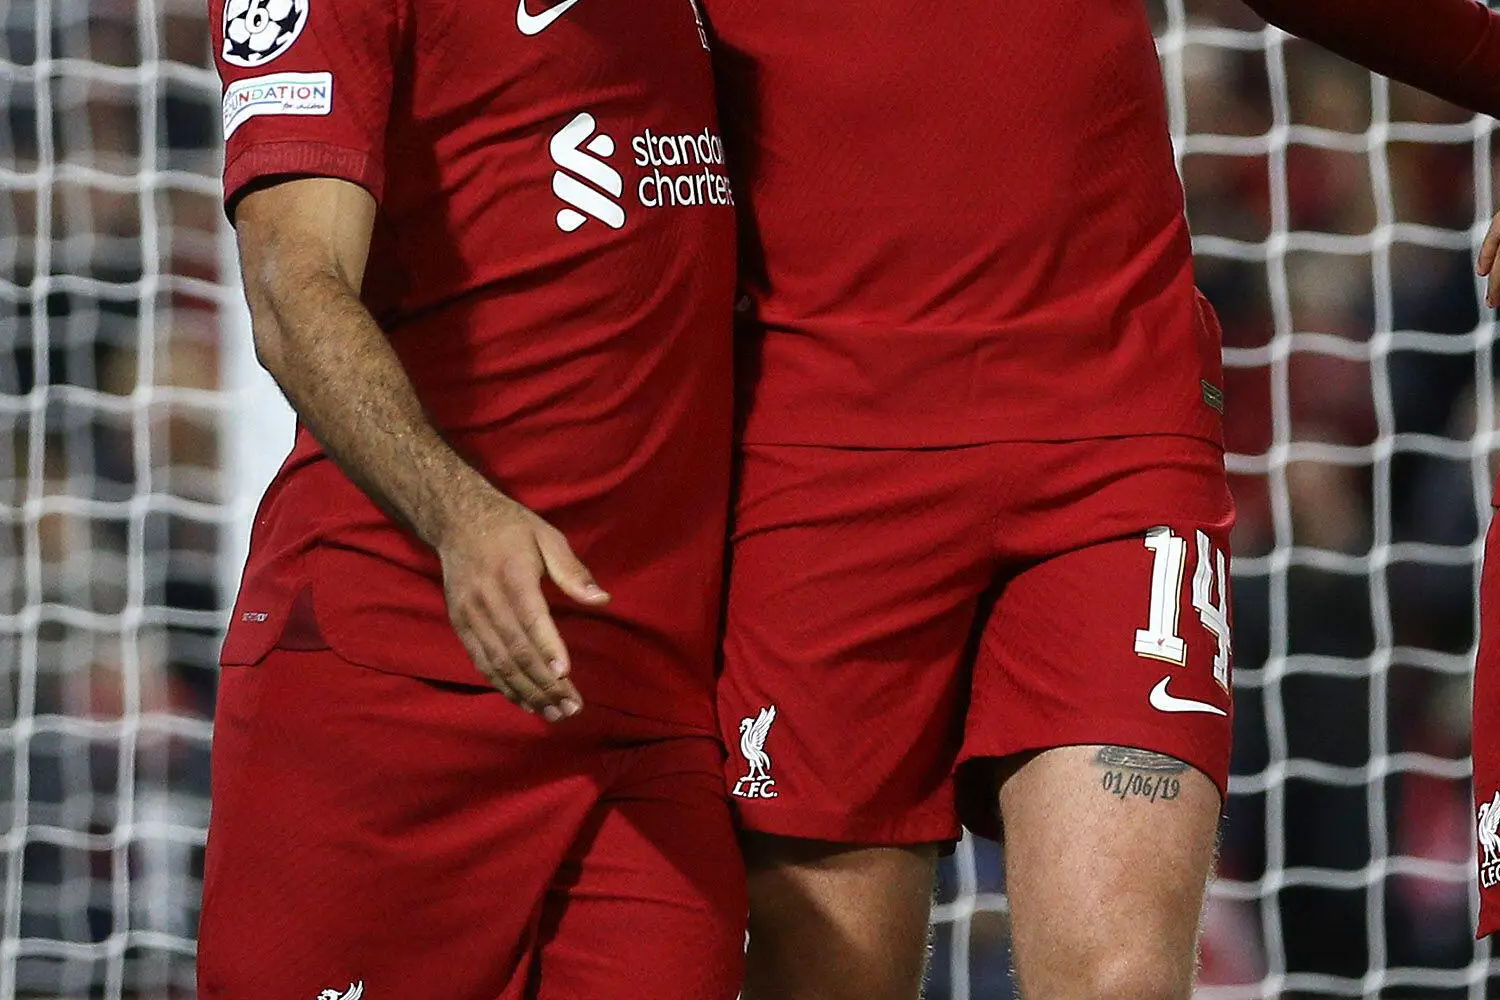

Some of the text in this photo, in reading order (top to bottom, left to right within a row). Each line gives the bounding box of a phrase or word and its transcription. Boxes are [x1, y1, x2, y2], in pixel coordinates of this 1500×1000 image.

[1135, 526, 1232, 695] 14
[732, 780, 778, 798] L.F.C.
[1102, 771, 1180, 804] 01/06/19
